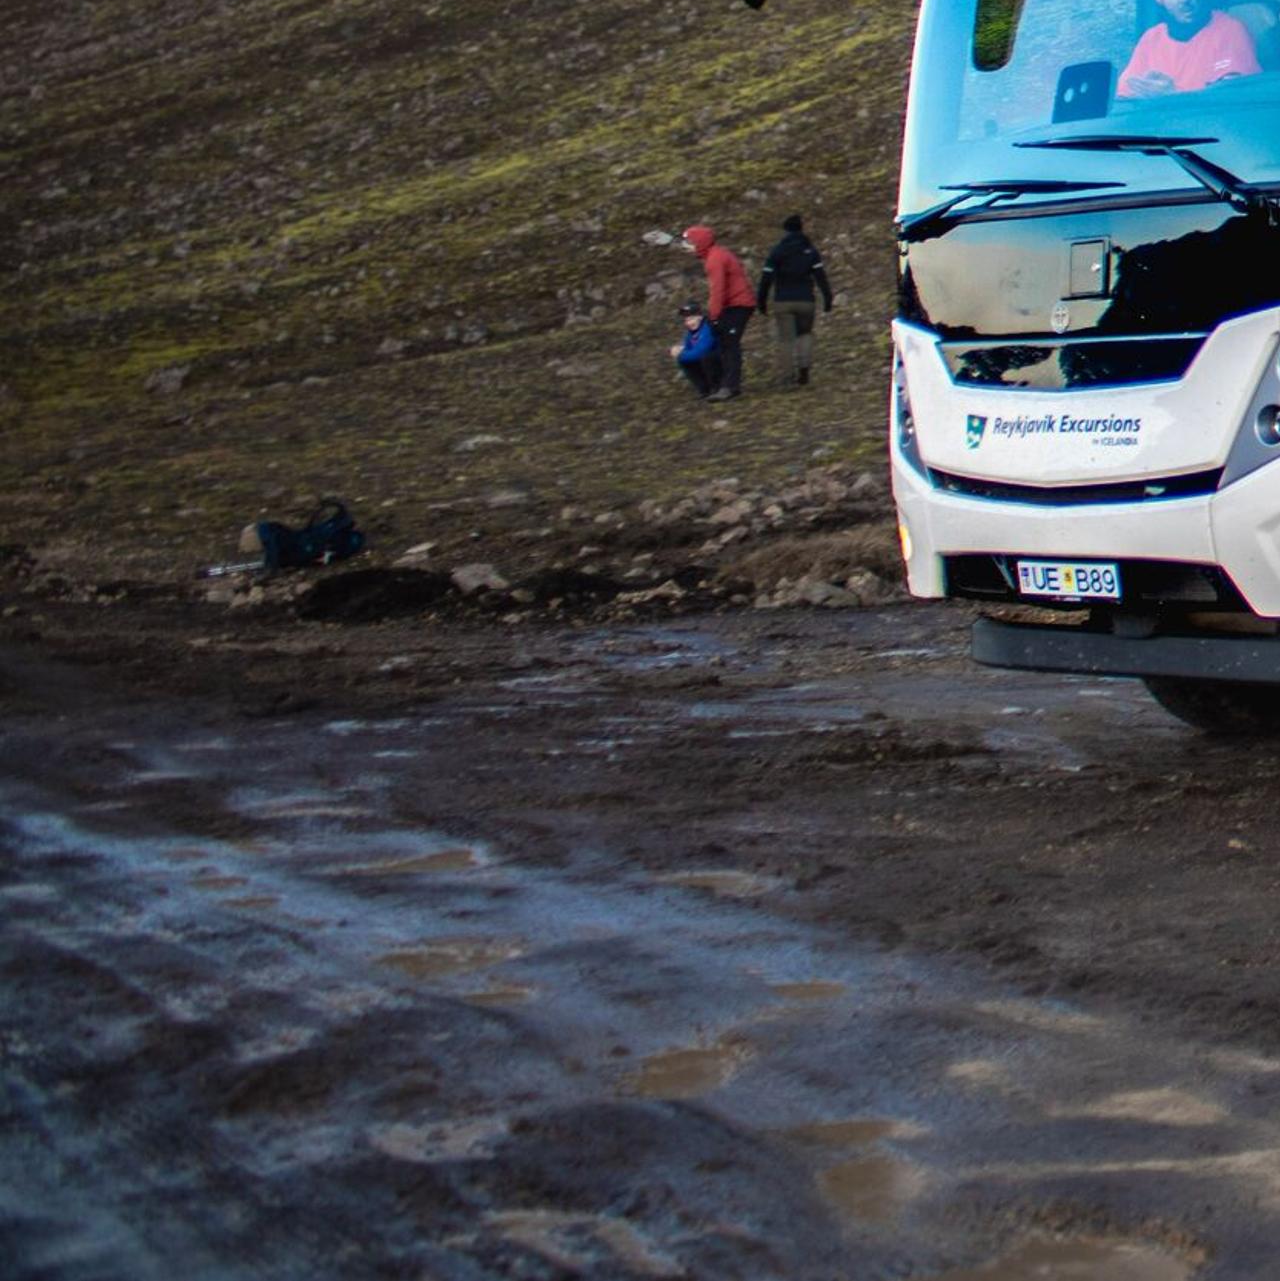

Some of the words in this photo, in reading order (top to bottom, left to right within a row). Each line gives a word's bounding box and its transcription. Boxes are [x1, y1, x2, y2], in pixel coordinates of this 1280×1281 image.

[993, 415, 1056, 439] Reykjavik
[1059, 413, 1142, 433] Excursions
[1032, 566, 1060, 591] UE
[1074, 568, 1116, 594] B89
